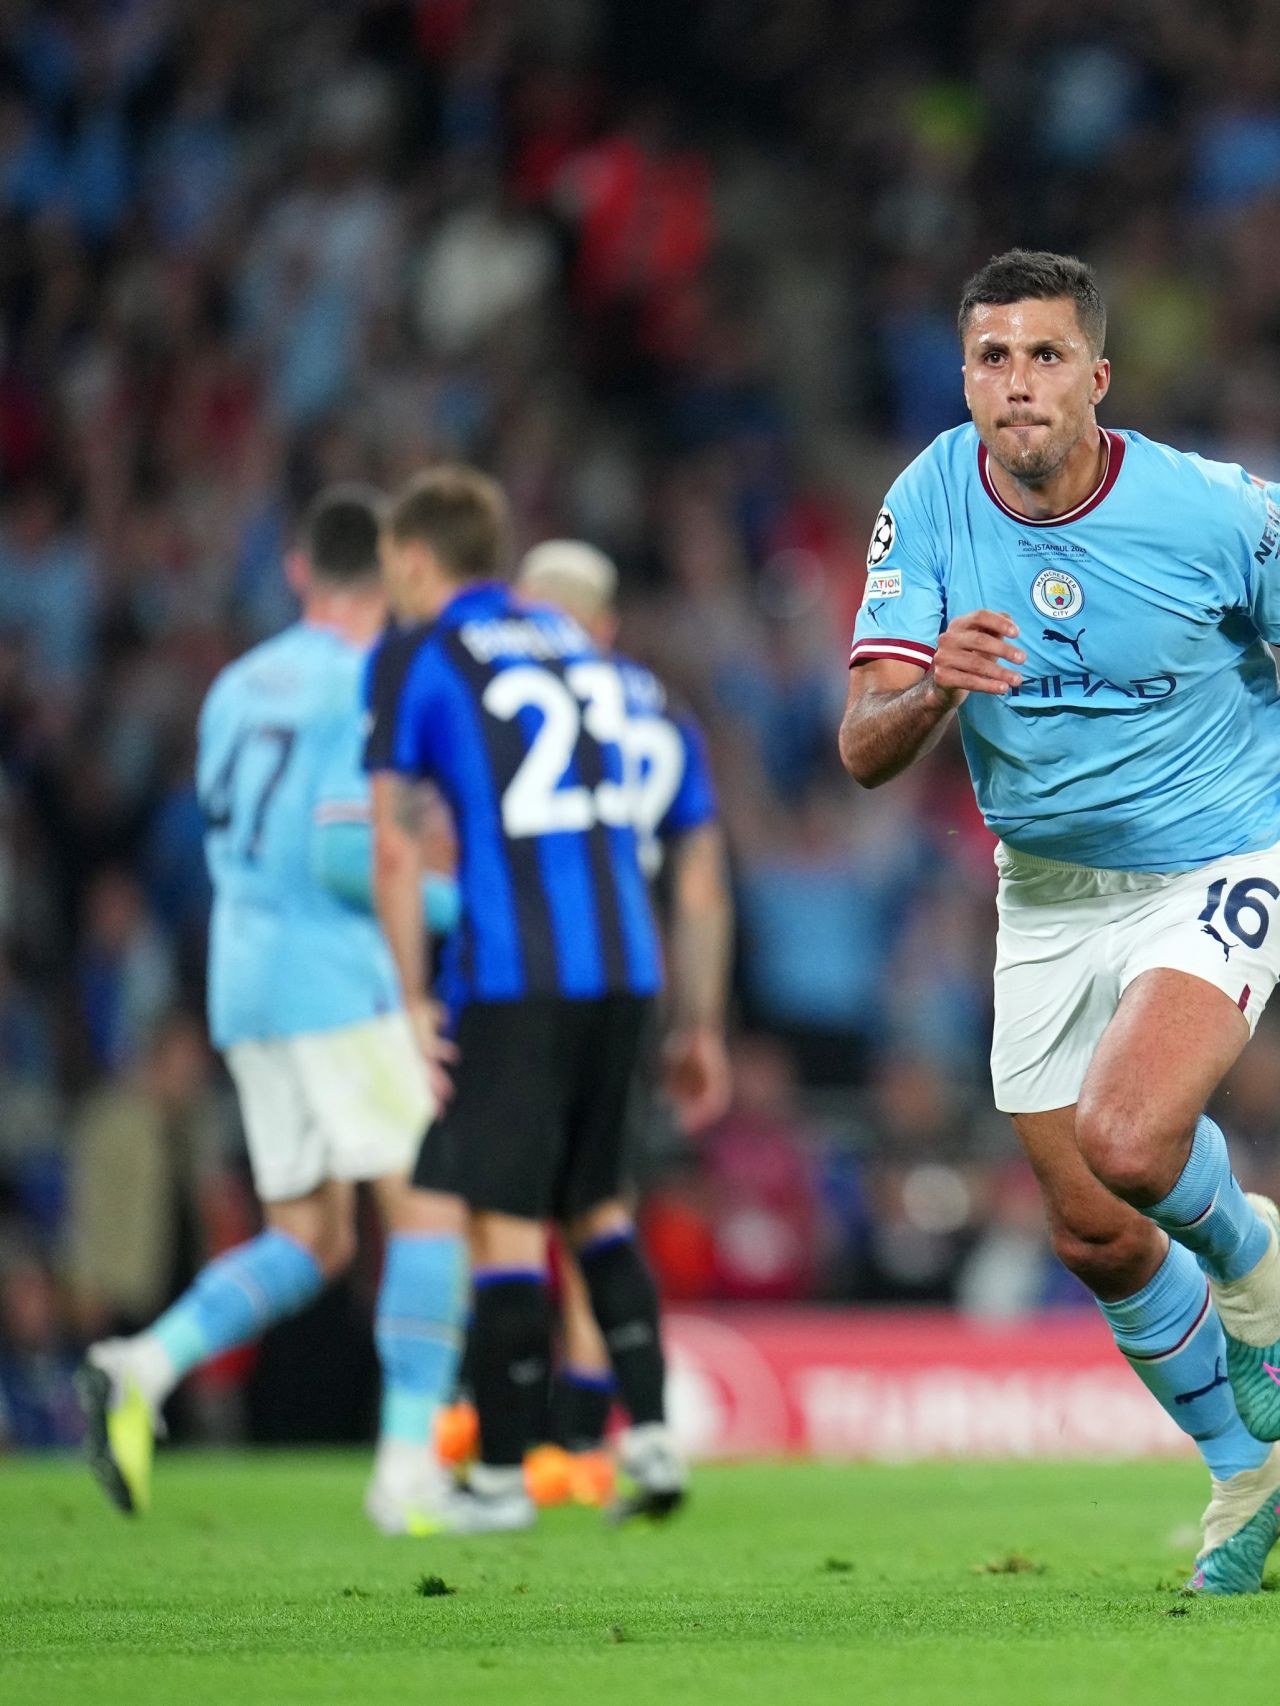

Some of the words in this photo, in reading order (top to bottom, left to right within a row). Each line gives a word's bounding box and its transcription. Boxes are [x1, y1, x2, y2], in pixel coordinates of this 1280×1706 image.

[1036, 571, 1077, 588] MANCHESTER
[1009, 673, 1177, 698] TIHAD
[483, 661, 640, 839] 23
[1197, 877, 1280, 949] 16
